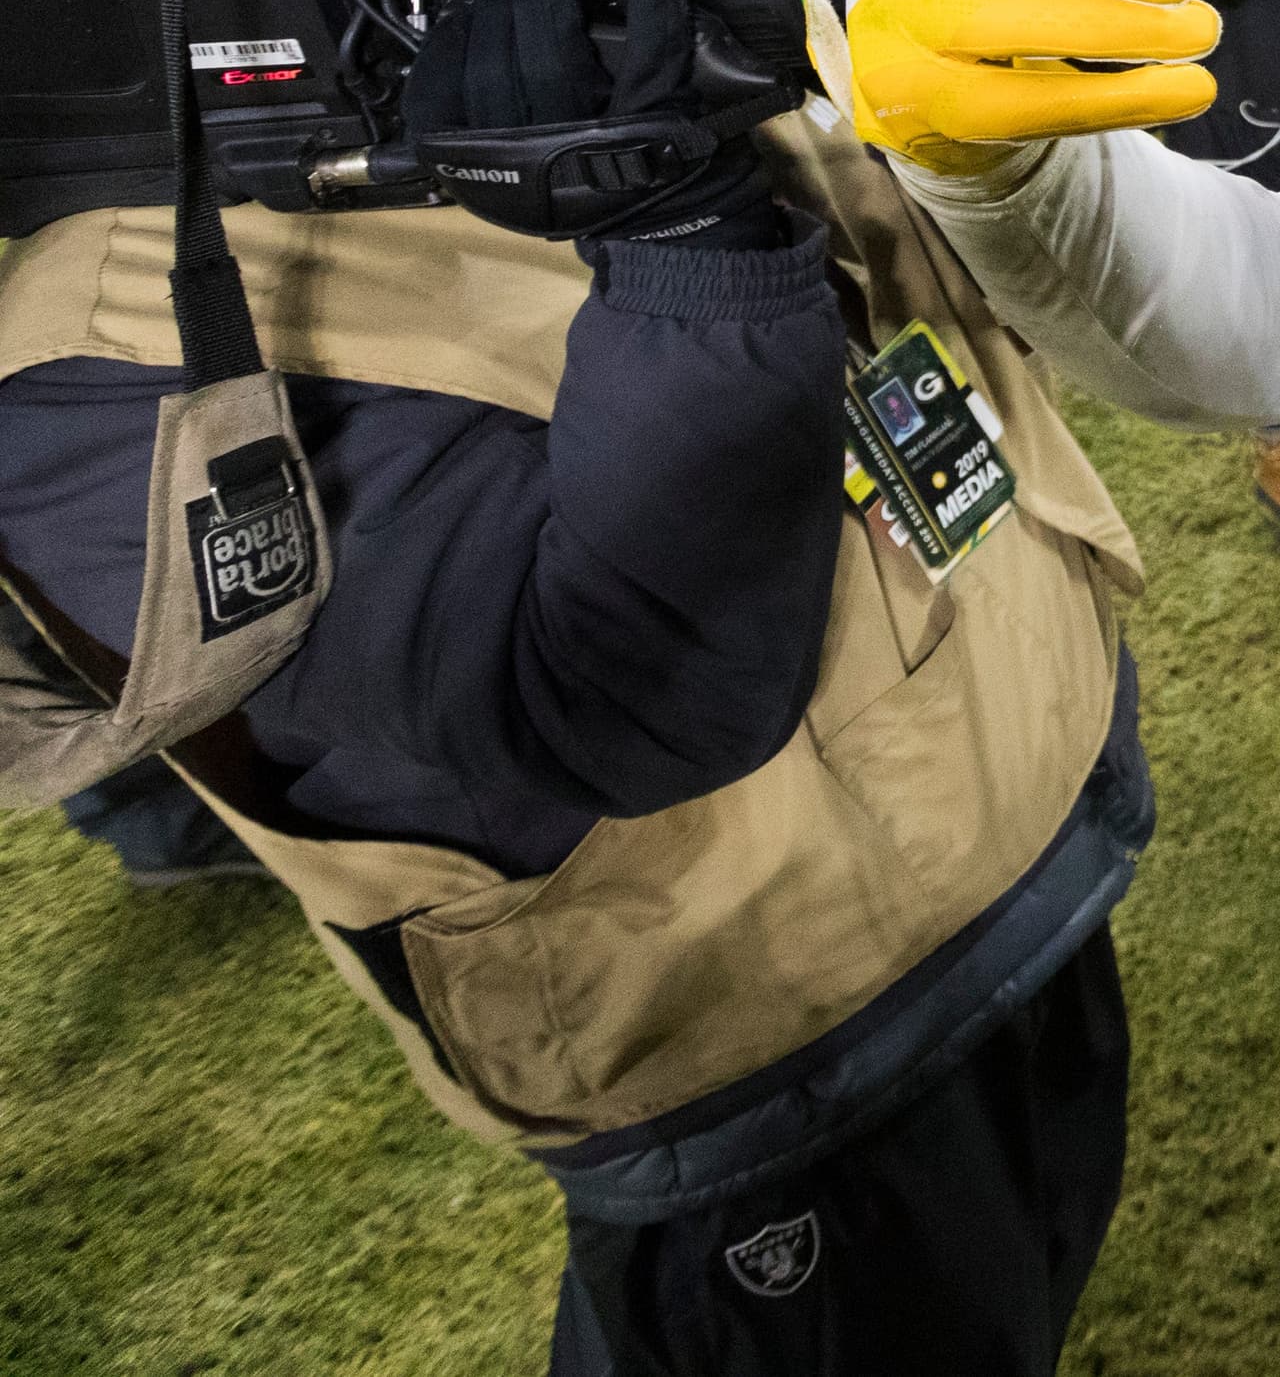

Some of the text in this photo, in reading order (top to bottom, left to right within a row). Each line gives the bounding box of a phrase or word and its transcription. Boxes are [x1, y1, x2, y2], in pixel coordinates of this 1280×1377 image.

[434, 163, 521, 185] Canon
[913, 372, 947, 402] G
[954, 439, 989, 479] 2019
[935, 459, 1004, 529] MEDIA
